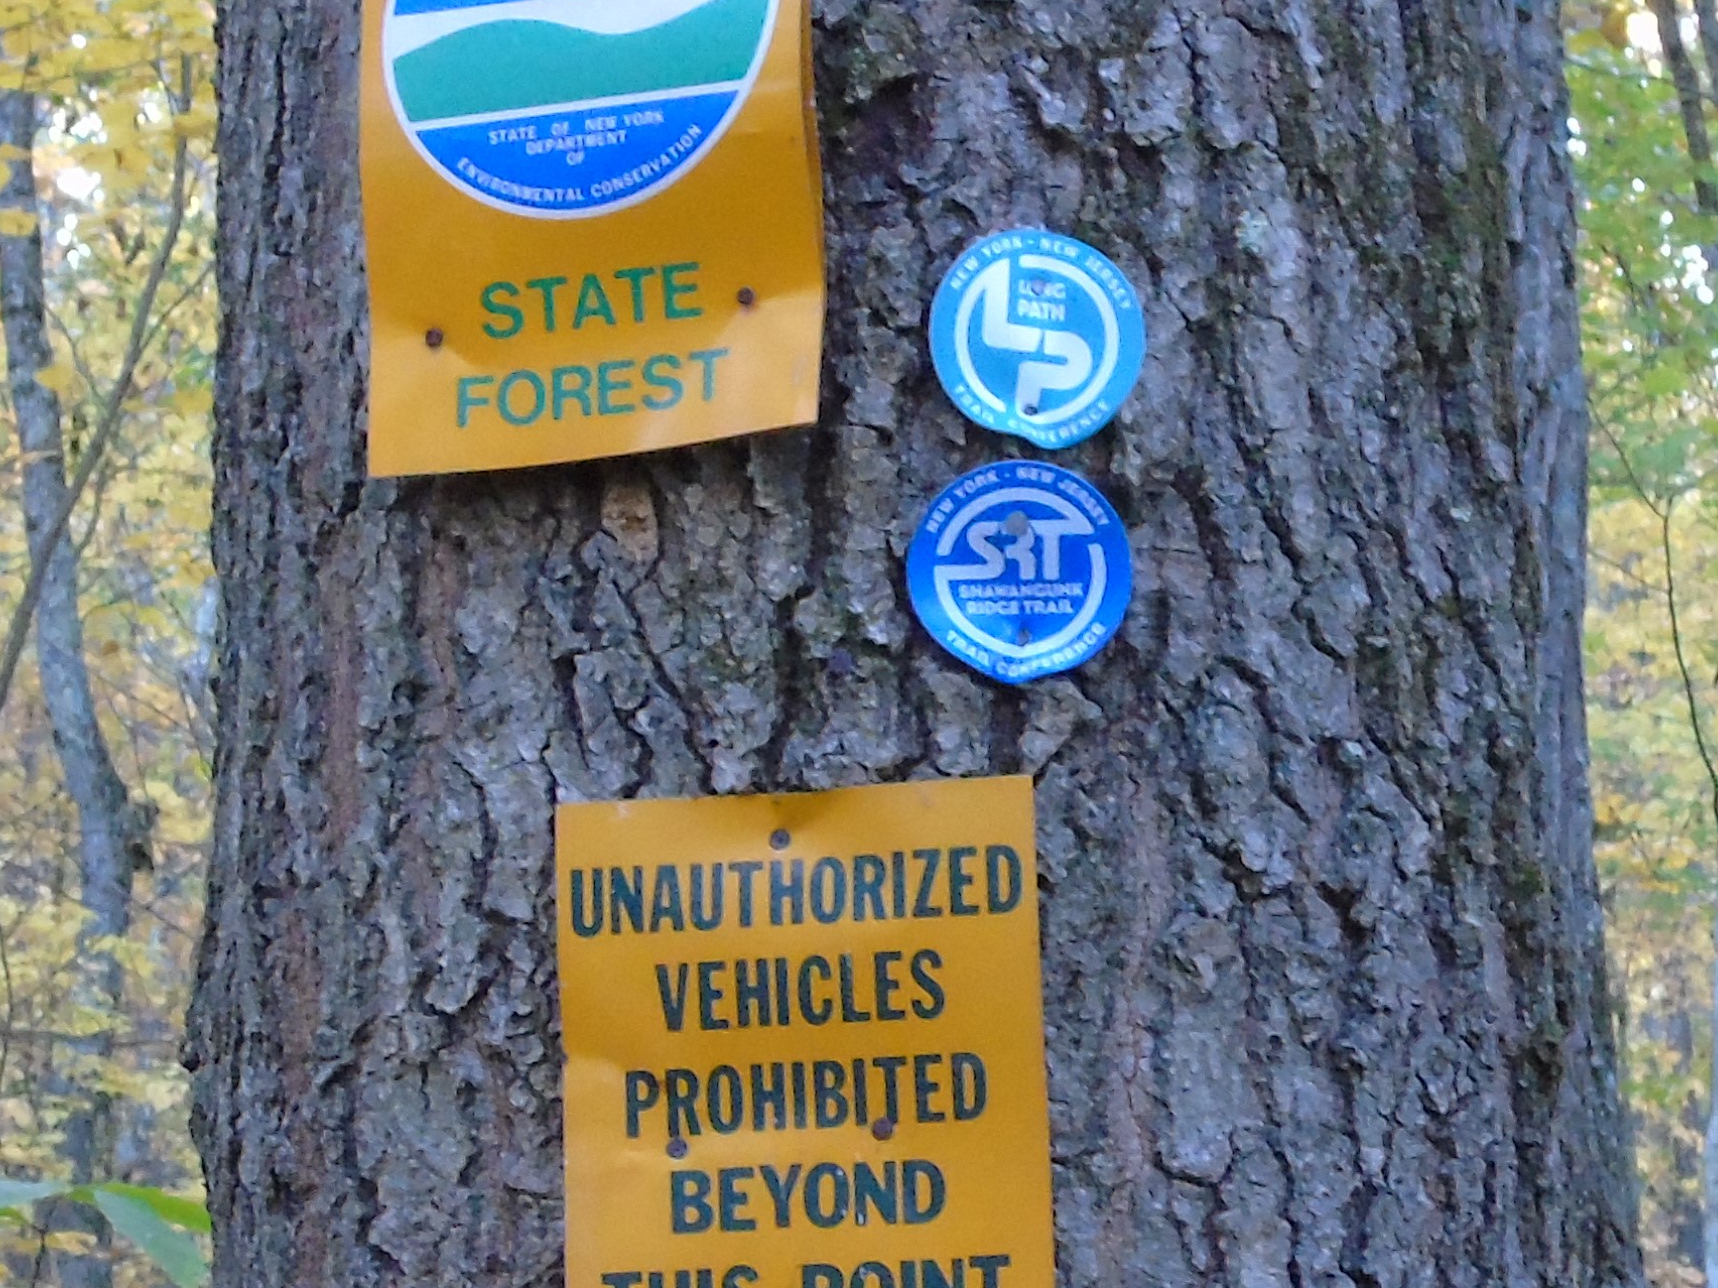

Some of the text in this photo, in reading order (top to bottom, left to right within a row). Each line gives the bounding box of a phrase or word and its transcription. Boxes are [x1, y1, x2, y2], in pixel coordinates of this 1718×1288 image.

[457, 124, 702, 202] ENVIRONMENTAL CONSERVATION
[488, 111, 664, 145] STATE OF NEW YORK
[526, 129, 627, 155] DEPARTMENT
[566, 150, 585, 166] OF
[480, 261, 703, 340] STATE
[1017, 298, 1065, 321] PATH
[455, 348, 729, 428] FOREST
[953, 469, 1000, 498] YORK
[1022, 598, 1074, 615] TRAIL
[569, 844, 1024, 938] UNAUTHORIZED
[655, 949, 946, 1032] VEHICLES
[624, 1052, 988, 1139] PROHIBITED
[669, 1159, 946, 1235] BEYOND
